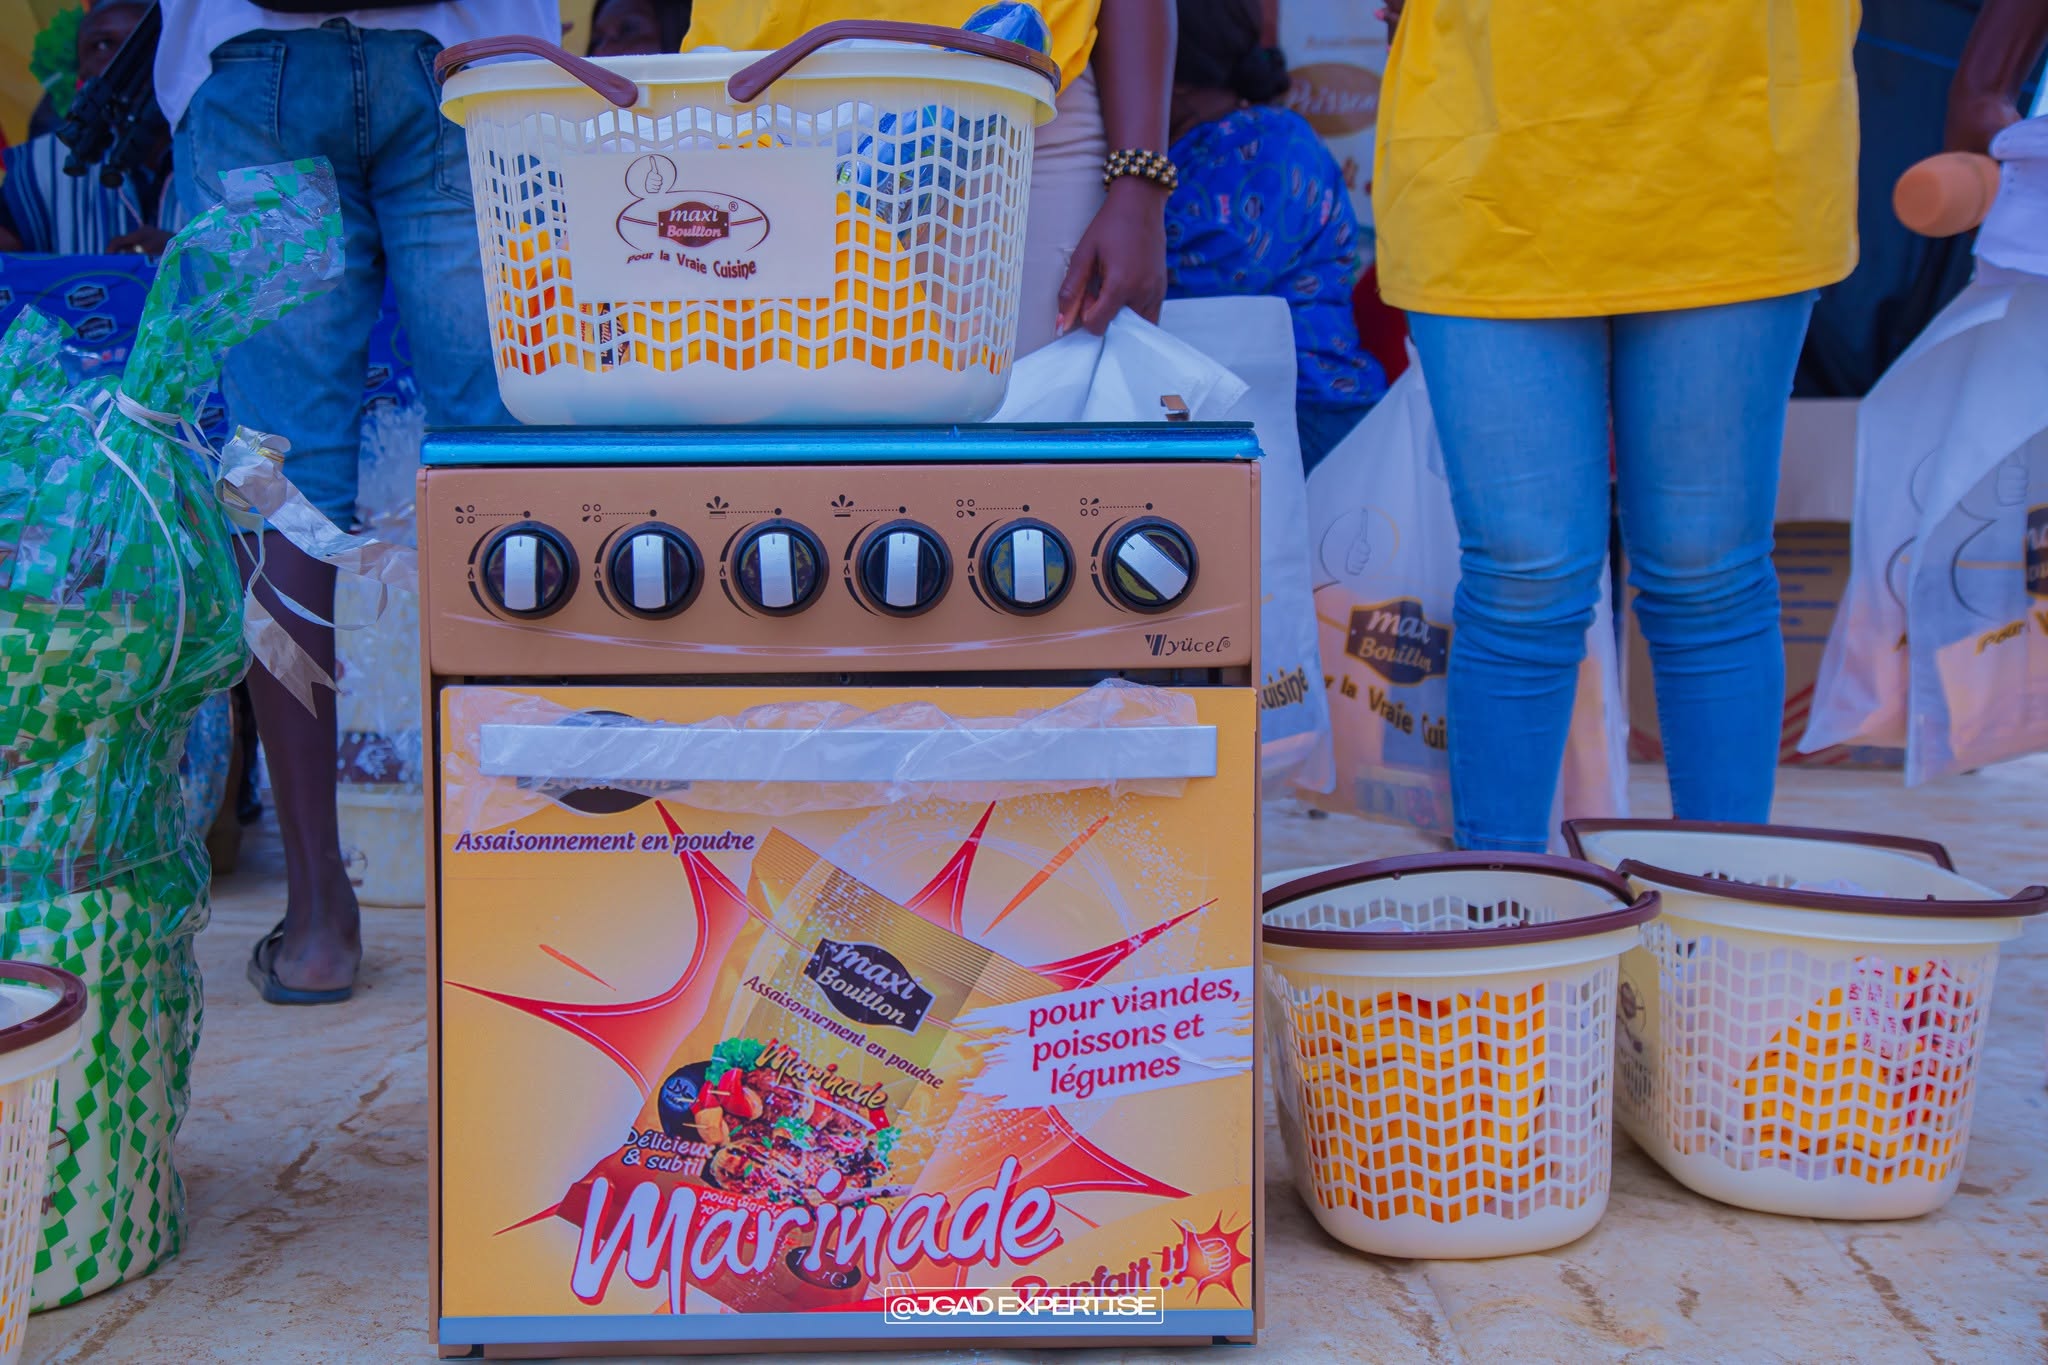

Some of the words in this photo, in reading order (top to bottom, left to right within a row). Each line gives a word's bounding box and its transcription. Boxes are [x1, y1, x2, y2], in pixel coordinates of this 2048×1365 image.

[666, 224, 722, 238] Bouillon
[669, 205, 720, 222] maxi
[626, 252, 654, 264] pour
[659, 250, 670, 262] la
[676, 252, 707, 274] Vraie
[713, 260, 757, 280] Cuisine
[1165, 636, 1230, 656] yücel
[1261, 664, 1309, 711] uisine
[1340, 674, 1358, 700] la
[1368, 686, 1414, 735] Vraie
[455, 830, 636, 852] Assaisonnement
[641, 834, 669, 852] en
[674, 830, 756, 855] poudre
[816, 965, 906, 1026] Bouillon
[831, 944, 922, 1001] maxi
[1028, 996, 1105, 1038] pour
[1112, 976, 1240, 1016] viandes,
[865, 1041, 886, 1060] en
[884, 1053, 944, 1090] poudre
[1032, 1022, 1167, 1072] poissons
[1173, 1013, 1206, 1041] et
[755, 1037, 889, 1111] Marinade
[1051, 1055, 1181, 1100] légumes
[623, 1148, 642, 1166] &
[646, 1153, 706, 1178] subtil
[568, 1153, 1064, 1316] Marinade
